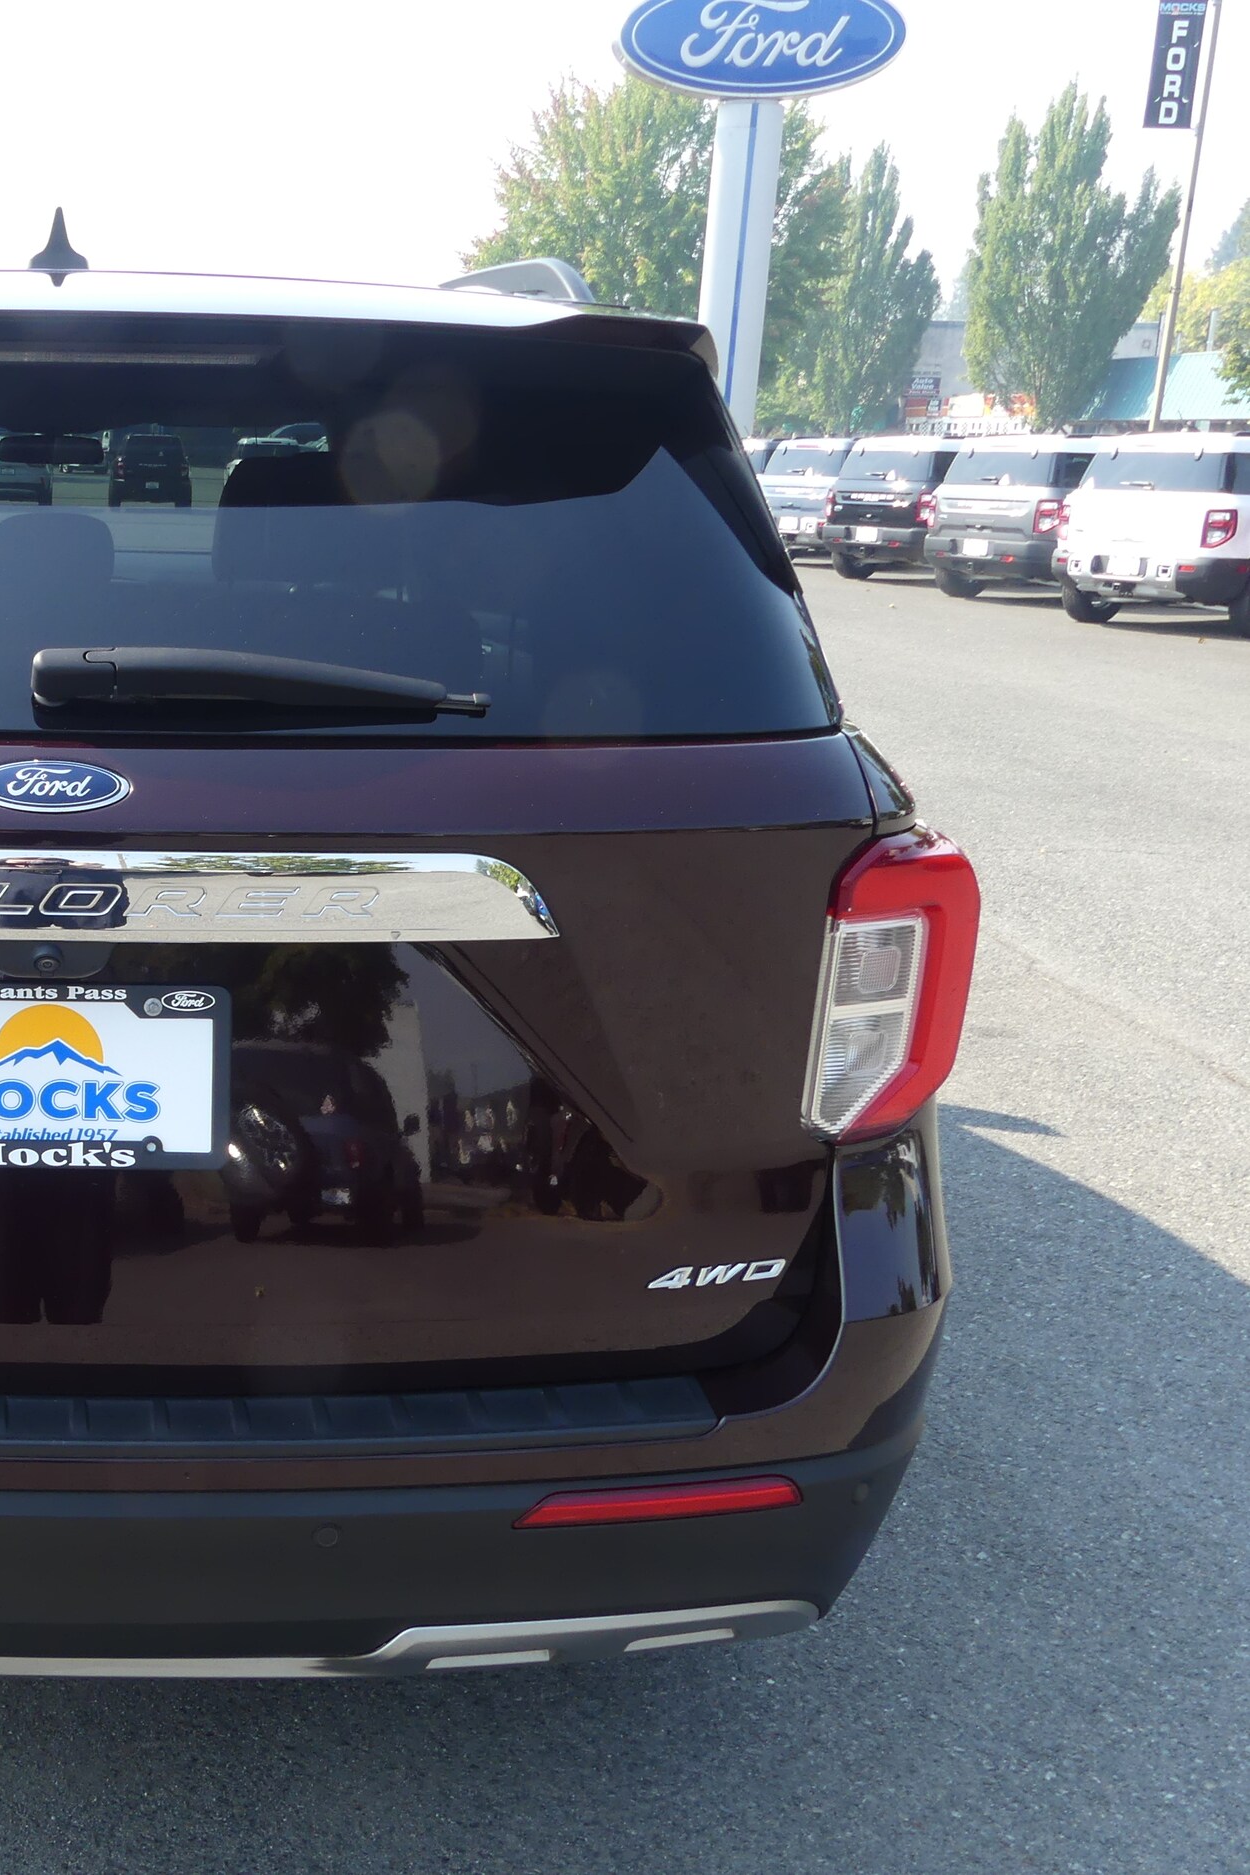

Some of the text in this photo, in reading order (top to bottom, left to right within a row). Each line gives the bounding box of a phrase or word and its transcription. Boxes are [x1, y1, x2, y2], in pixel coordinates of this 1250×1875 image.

[1160, 2, 1206, 12] MOCKS
[680, 0, 851, 68] Ford
[1158, 20, 1190, 125] FORD
[6, 766, 93, 797] Ford
[66, 985, 127, 1001] Pass
[171, 993, 205, 1008] Ford
[76, 1128, 119, 1141] 1957
[647, 1258, 786, 1290] 4WD
